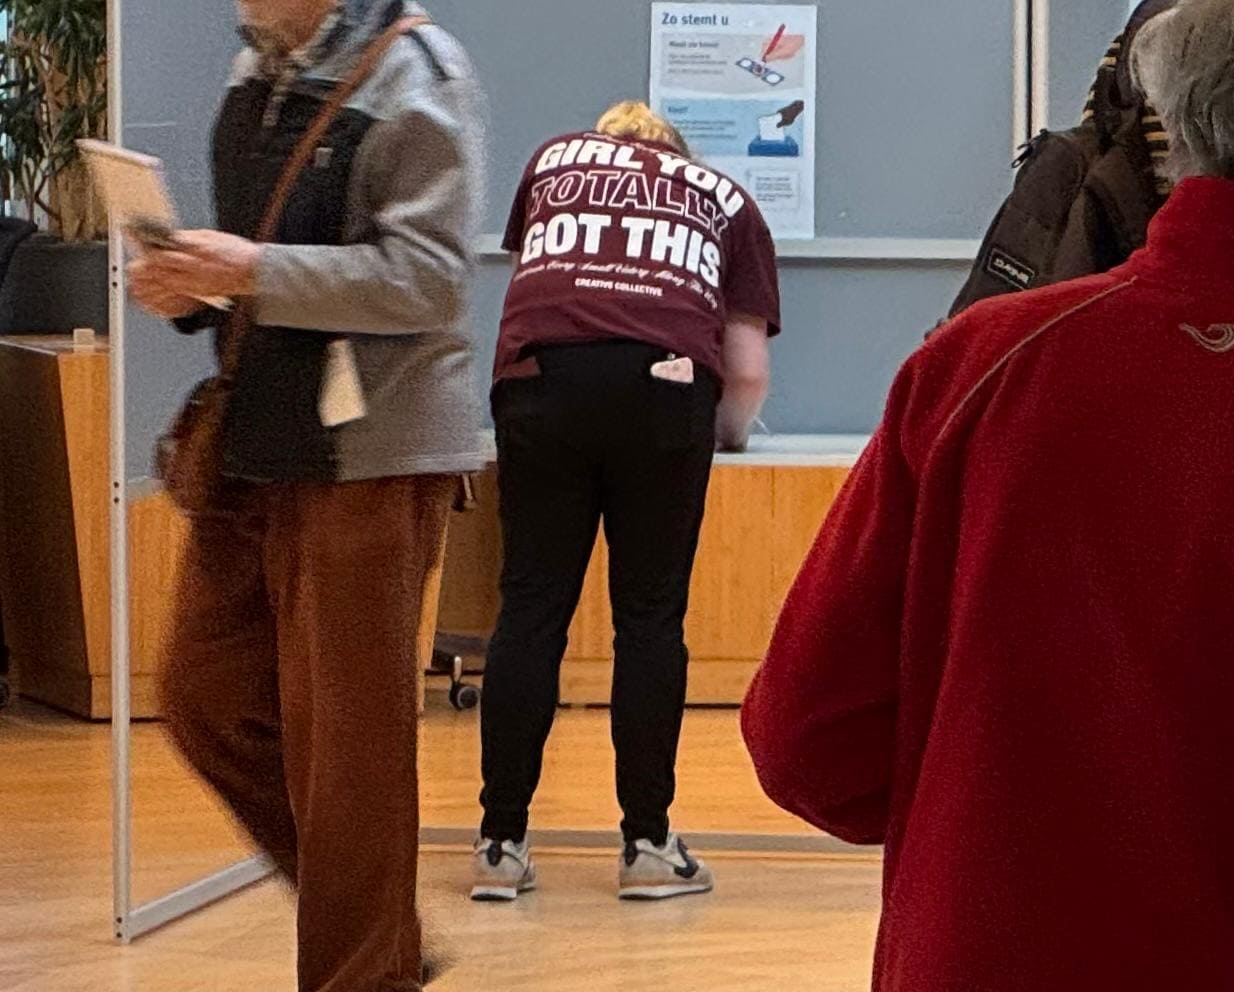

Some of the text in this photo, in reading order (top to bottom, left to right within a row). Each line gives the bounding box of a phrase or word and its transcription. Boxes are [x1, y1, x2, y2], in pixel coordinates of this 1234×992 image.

[661, 12, 729, 26] Zo stemt u
[530, 170, 729, 241] TOTALLY
[534, 139, 644, 174] GIRL
[656, 153, 745, 218] YOU
[520, 213, 721, 289] GOT THIS
[575, 278, 663, 297] CREATIVE COLLECTIVE
